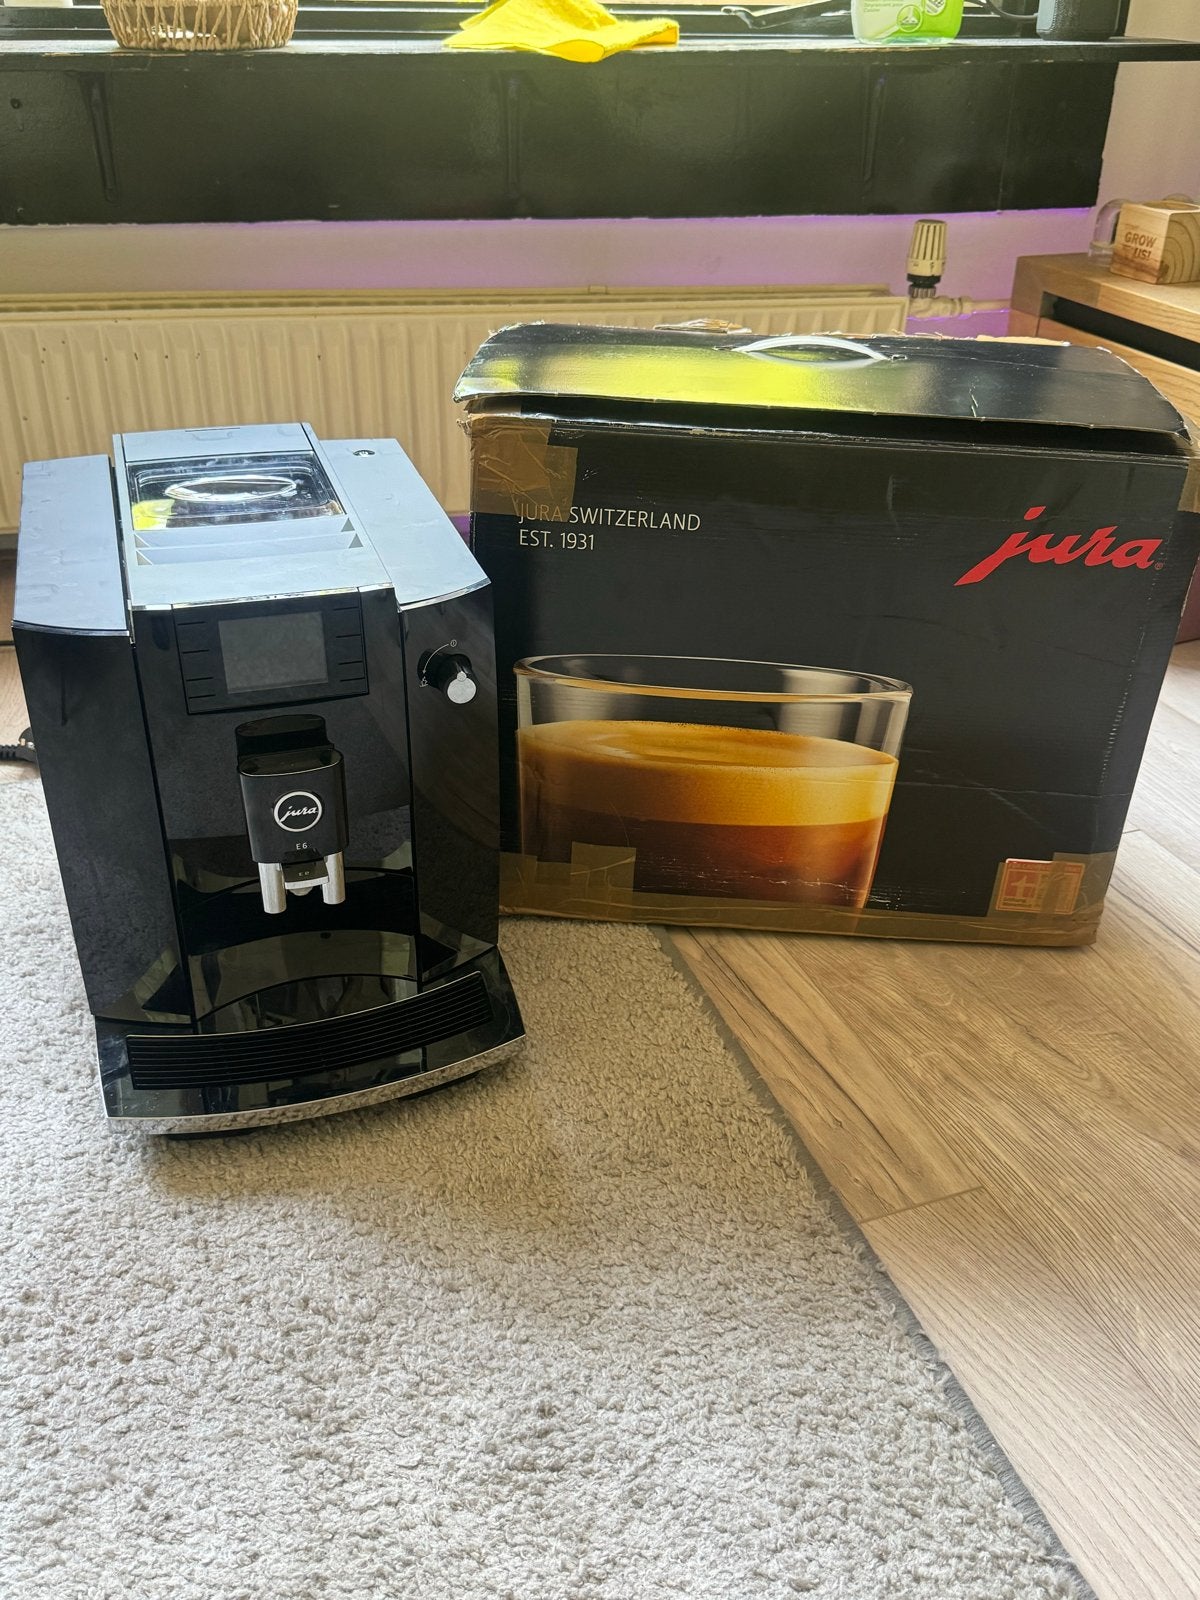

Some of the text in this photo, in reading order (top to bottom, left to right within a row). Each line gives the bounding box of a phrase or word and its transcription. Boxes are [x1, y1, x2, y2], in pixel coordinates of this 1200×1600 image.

[1125, 232, 1156, 248] GROW
[1134, 248, 1151, 260] US!
[518, 503, 701, 532] JURA SWITZERLAND
[518, 529, 595, 551] EST. 1931
[279, 805, 318, 822] jura
